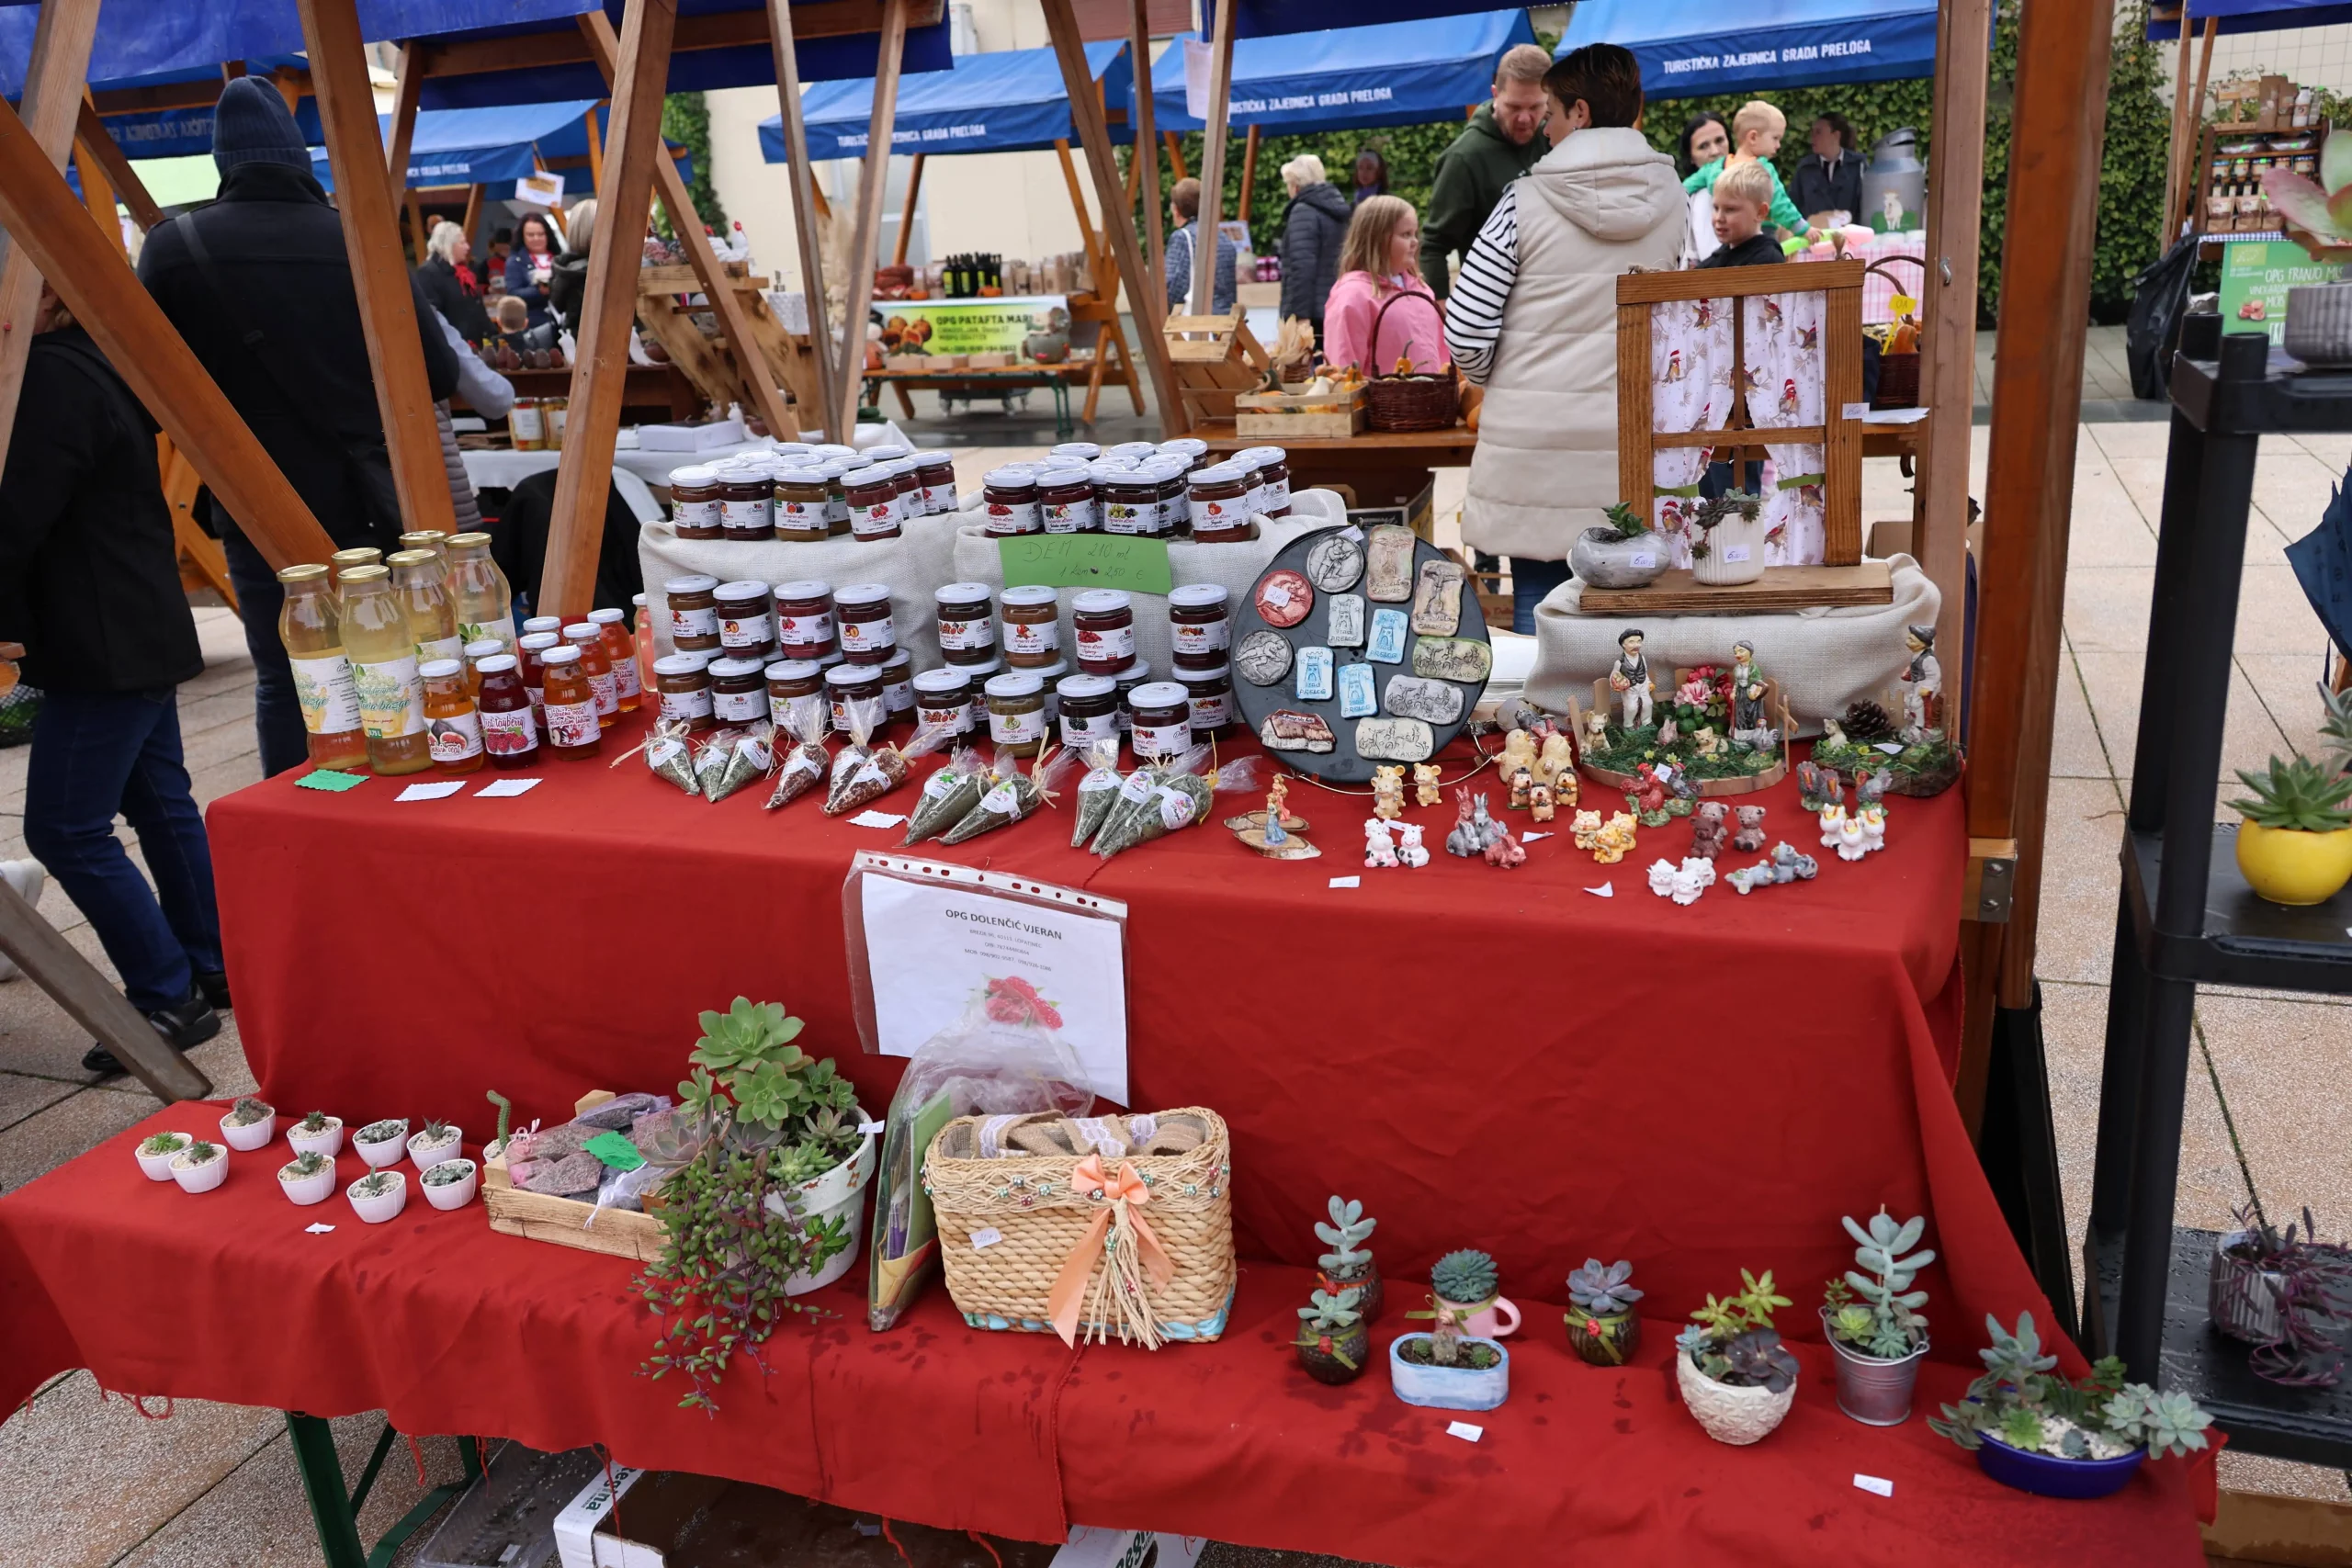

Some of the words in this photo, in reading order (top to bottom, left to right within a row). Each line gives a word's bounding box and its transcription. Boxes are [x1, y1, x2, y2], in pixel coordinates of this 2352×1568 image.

[1663, 56, 1719, 74] TURISTIČKA
[1723, 50, 1777, 68] ZAJEDNICA
[1781, 46, 1818, 62] GRADA
[1821, 39, 1871, 59] PRELOGA
[1317, 92, 1349, 107] GRADA
[1350, 86, 1393, 104] PRELOGA
[2288, 266, 2323, 282] FRANJO
[379, 700, 411, 714] bazge
[495, 714, 526, 729] tayberry
[945, 908, 967, 920] OPG
[970, 913, 1022, 931] DOLENČIĆ
[1023, 923, 1063, 940] VJERAN
[1014, 937, 1043, 949] LOPATINEC
